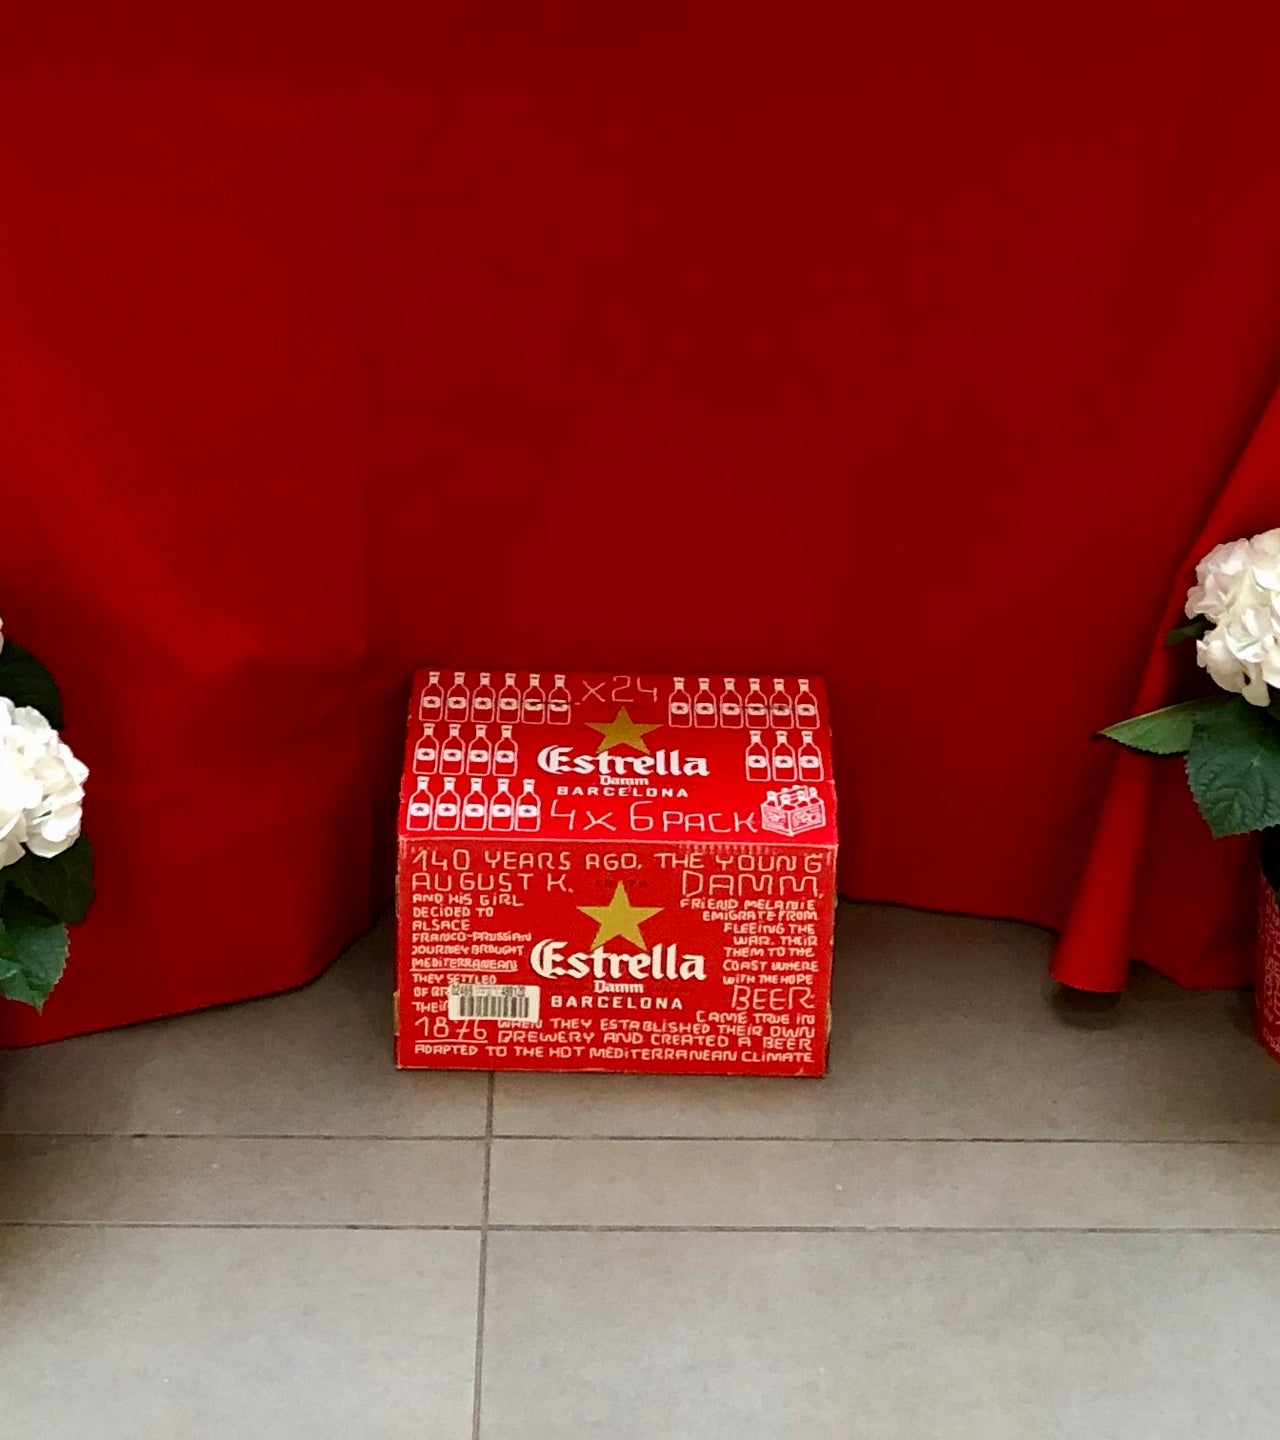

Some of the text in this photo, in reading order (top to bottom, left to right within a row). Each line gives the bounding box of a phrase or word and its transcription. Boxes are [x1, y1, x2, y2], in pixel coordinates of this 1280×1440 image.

[537, 745, 710, 777] Estrella
[600, 775, 649, 786] Damm
[557, 786, 689, 798] BARCELONA
[413, 849, 470, 872] 140
[484, 851, 571, 870] YEARS
[654, 852, 704, 869] THE
[715, 853, 823, 873] YOUNG
[412, 872, 533, 893] AUGUST
[546, 873, 574, 893] K.
[412, 894, 444, 905] AND
[476, 906, 494, 918] TO
[778, 910, 818, 922] FROM
[412, 920, 471, 932] ALSACE
[788, 923, 816, 935] THE
[411, 944, 467, 956] JOURNEY
[724, 947, 764, 958] THEM
[788, 947, 816, 958] THE
[530, 939, 707, 981] Estrella
[722, 960, 767, 972] COAST
[771, 961, 819, 972] WHERE
[412, 973, 444, 984] THEY
[447, 973, 497, 985] SETTLED
[759, 974, 779, 985] THE
[780, 974, 814, 985] HOPE
[594, 980, 644, 993] Damm
[551, 995, 683, 1010] BARCELONA
[696, 1010, 748, 1024] CAME
[752, 1012, 790, 1025] TRUE
[551, 1018, 593, 1030] THEY
[770, 1026, 815, 1039] OWN
[497, 1030, 813, 1052] BREWERY AND CREATED A BEER
[414, 1044, 478, 1056] ADAPTED
[485, 1045, 508, 1057] TO
[512, 1046, 545, 1058] THE
[548, 1046, 586, 1058] HOT
